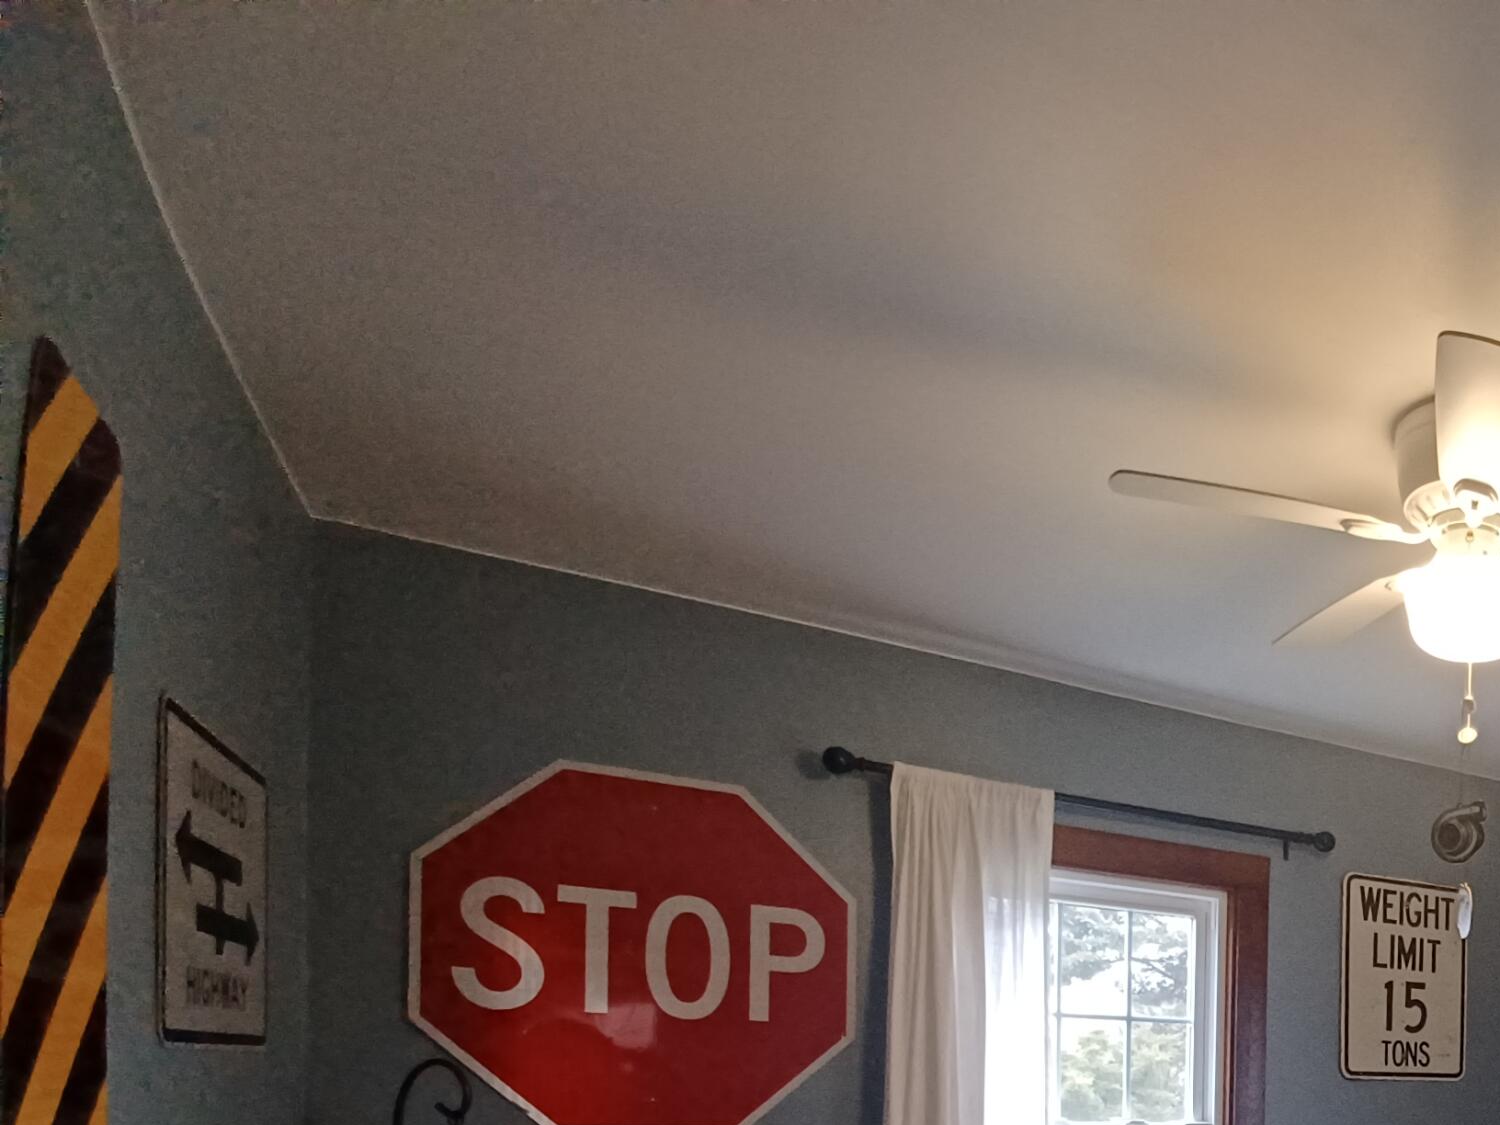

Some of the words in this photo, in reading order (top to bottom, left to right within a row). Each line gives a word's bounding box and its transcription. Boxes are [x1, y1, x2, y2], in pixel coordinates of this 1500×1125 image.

[1359, 885, 1455, 931] WEIGHT
[450, 875, 827, 1023] STOP
[1372, 932, 1441, 974] LIMIT
[1383, 979, 1428, 1034] 15
[1381, 1039, 1431, 1068] TONS
